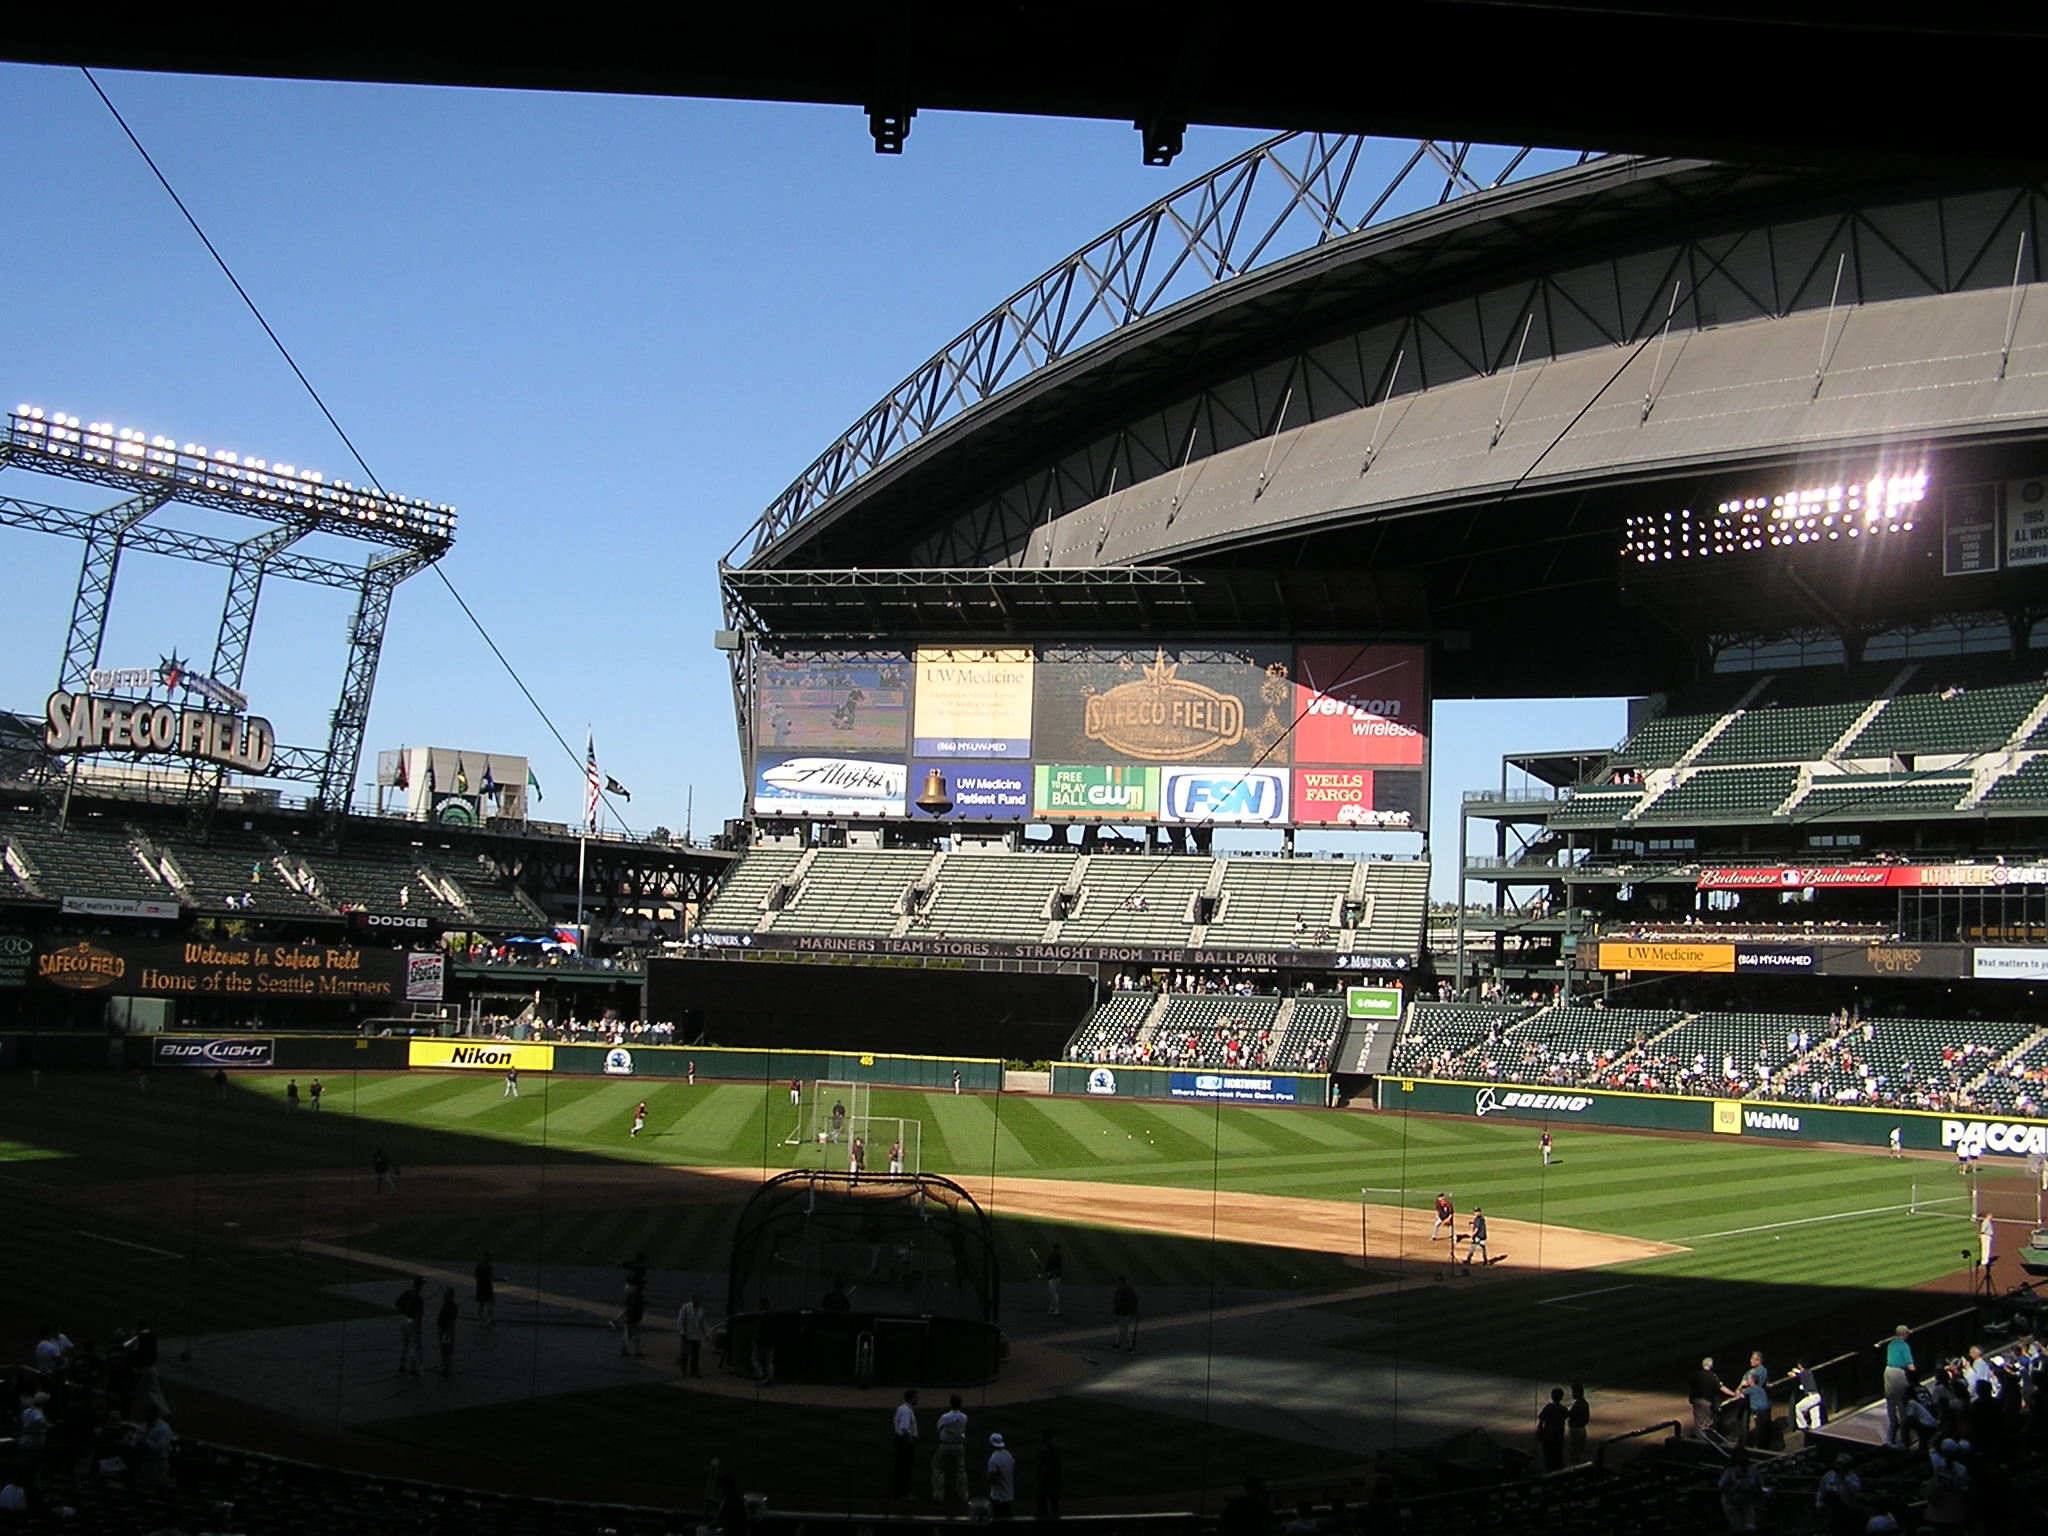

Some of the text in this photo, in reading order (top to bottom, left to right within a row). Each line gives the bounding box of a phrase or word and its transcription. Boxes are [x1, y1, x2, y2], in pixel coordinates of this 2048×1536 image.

[927, 669, 1024, 684] UW Medicine
[1307, 694, 1401, 720] verizon
[1089, 700, 1238, 736] SAFECO FIELD
[46, 690, 177, 752] SAFECO
[181, 710, 275, 774] FIELD
[1352, 720, 1418, 737] wireless
[796, 762, 884, 790] Alaska
[1057, 772, 1083, 783] FREE
[1304, 774, 1363, 787] WELLS
[956, 778, 1022, 790] UW Medicine
[1061, 783, 1087, 794] PLAY
[956, 792, 1026, 806] Patient Fund
[1052, 793, 1087, 806] BALL
[1185, 780, 1265, 814] FSN
[1305, 789, 1363, 802] FARGO
[1700, 869, 1883, 886] Budweiser Budweiser
[1921, 868, 1940, 884] HIT
[1943, 868, 1956, 884] IT
[1959, 868, 1989, 884] HERE
[86, 902, 112, 911] matters
[368, 915, 428, 928] DODGE
[184, 943, 360, 970] Welcome to Safeco Field
[800, 938, 875, 951] MARINERS
[883, 940, 924, 952] TEAM
[1016, 946, 1093, 959] STRAIGHT
[1100, 949, 1142, 961] FROM
[1152, 950, 1182, 962] THE
[1194, 951, 1277, 965] BALLPARK
[1628, 947, 1704, 961] UW Medicine
[1867, 947, 1922, 964] MARINERS
[39, 954, 125, 979] SAFECO FIELD
[1350, 955, 1394, 969] MARINERS
[1759, 954, 1812, 966] MY-UW-MED
[1874, 960, 1914, 973] Care
[1977, 959, 1996, 967] What
[1998, 960, 2029, 968] matters
[2031, 960, 2039, 968] to
[140, 968, 197, 991] Home
[201, 970, 223, 990] of
[225, 971, 252, 991] the
[256, 973, 314, 994] Seattle
[318, 975, 392, 996] Mariners
[160, 1045, 267, 1057] BUD LIGHT
[451, 1047, 512, 1065] Nikon
[1224, 1078, 1272, 1090] NORTHWEST
[1171, 1089, 1294, 1101] Where Northwest Fans Come First
[1501, 1092, 1587, 1111] BOEING
[1743, 1111, 1800, 1131] WaMu
